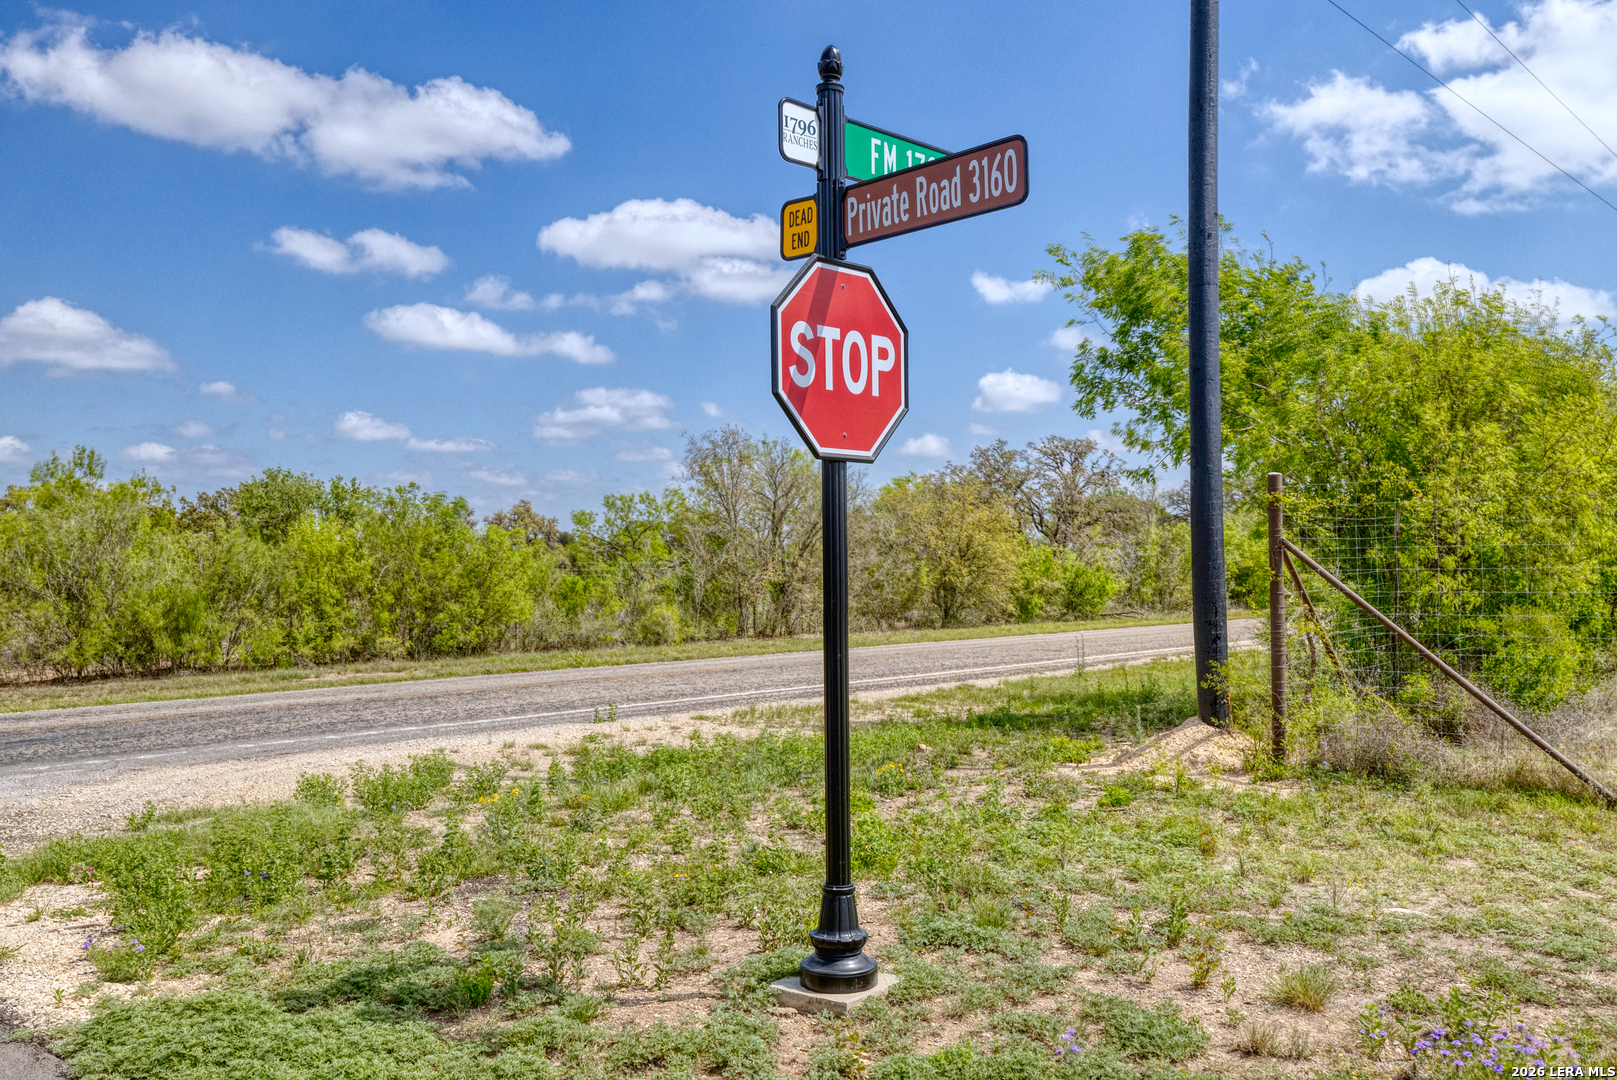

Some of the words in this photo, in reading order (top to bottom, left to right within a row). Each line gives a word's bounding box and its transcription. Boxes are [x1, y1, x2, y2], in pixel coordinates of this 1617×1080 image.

[784, 114, 816, 136] 1796
[783, 132, 818, 151] RANCHES
[870, 137, 897, 175] FM
[847, 183, 910, 236] Private
[916, 164, 962, 218] Road
[968, 148, 1018, 204] 3160
[789, 206, 813, 228] DEAD
[791, 230, 810, 251] END
[788, 320, 896, 397] STOP
